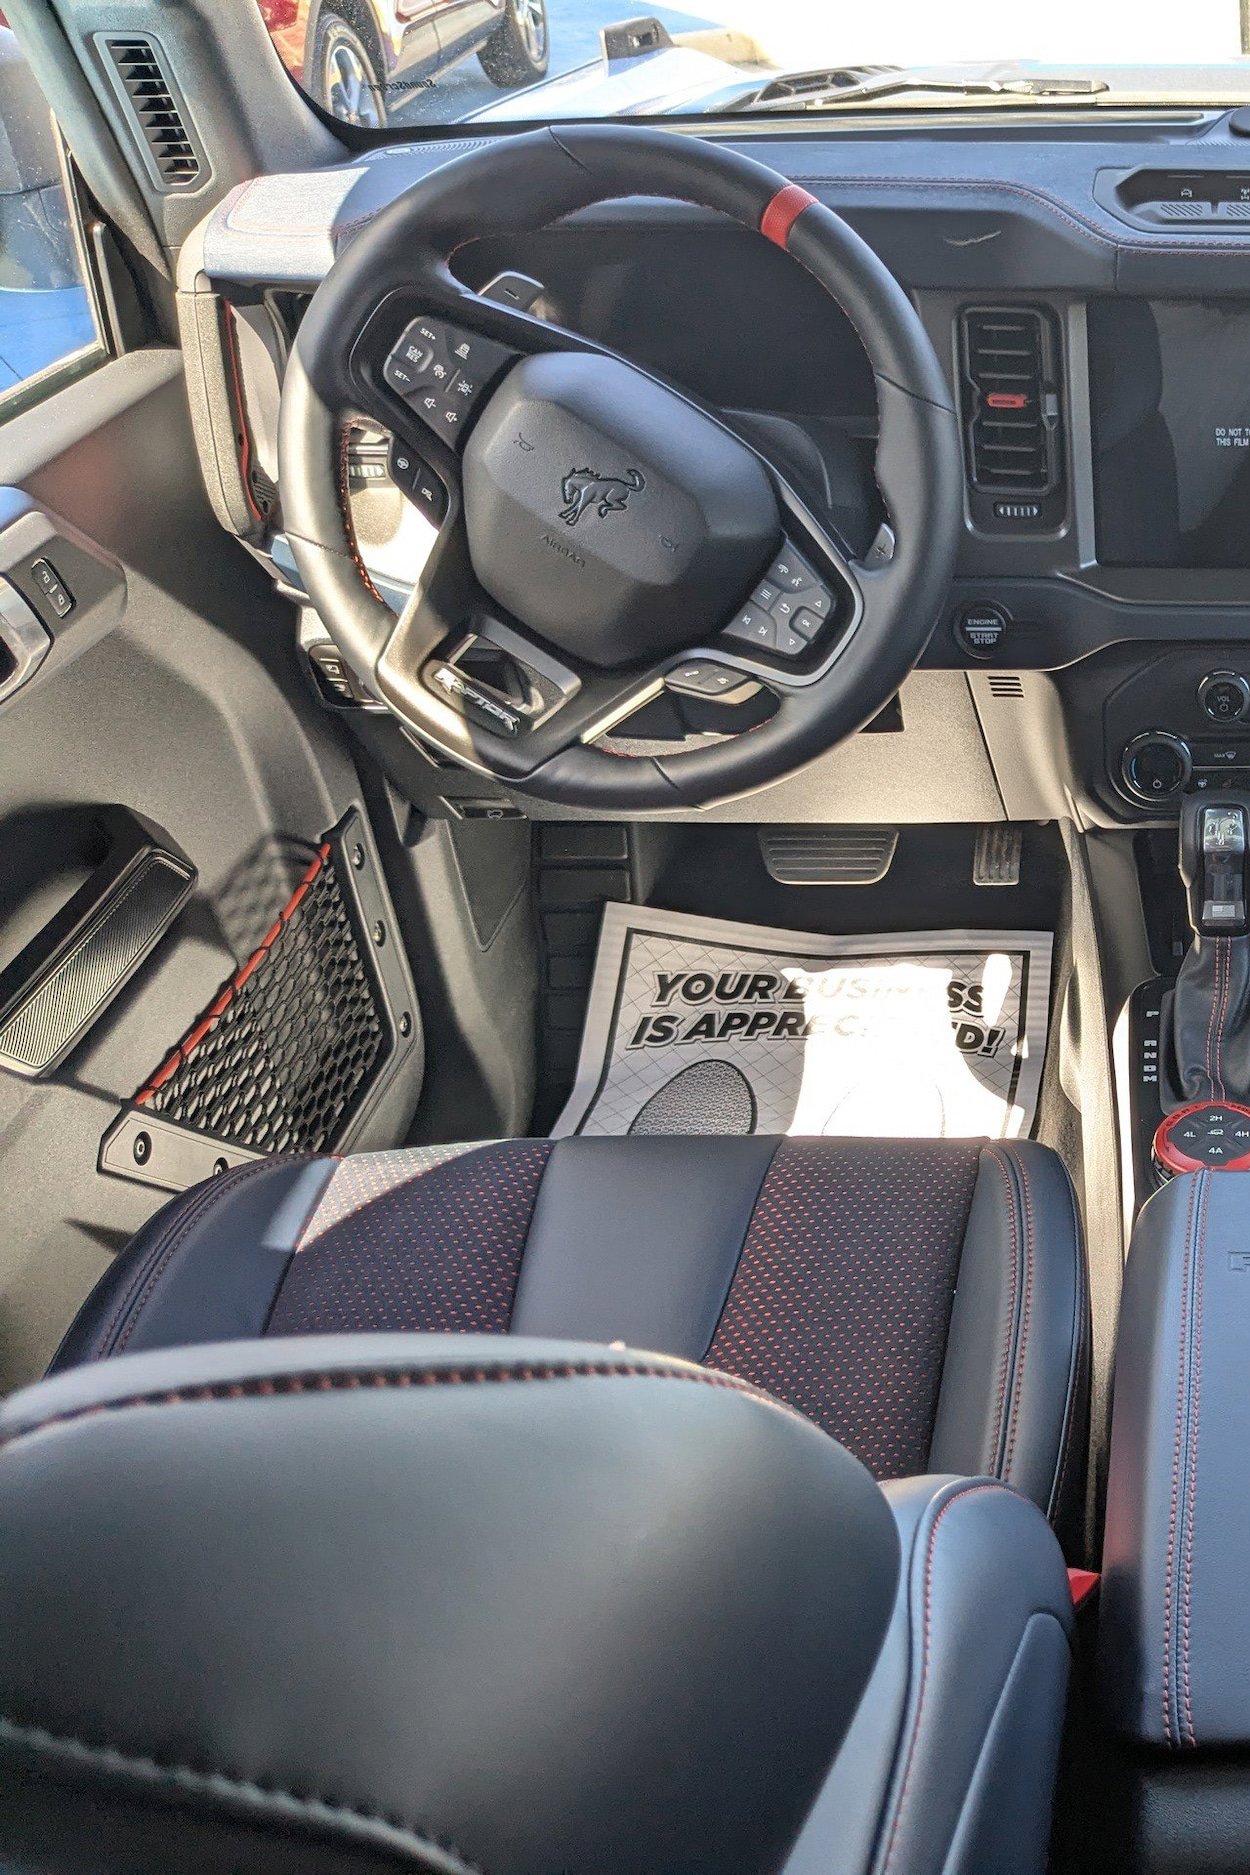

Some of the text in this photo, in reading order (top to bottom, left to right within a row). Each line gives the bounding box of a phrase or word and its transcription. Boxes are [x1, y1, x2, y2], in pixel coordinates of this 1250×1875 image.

[1215, 428, 1226, 437] DO
[1228, 428, 1242, 437] NOT
[1216, 438, 1231, 447] THIS
[1234, 438, 1249, 447] FILM
[967, 618, 999, 626] ENGINE
[656, 972, 986, 1016] YOUR BUSSS
[630, 1011, 1005, 1055] IS APPRECD!
[1142, 1075, 1158, 1083] M
